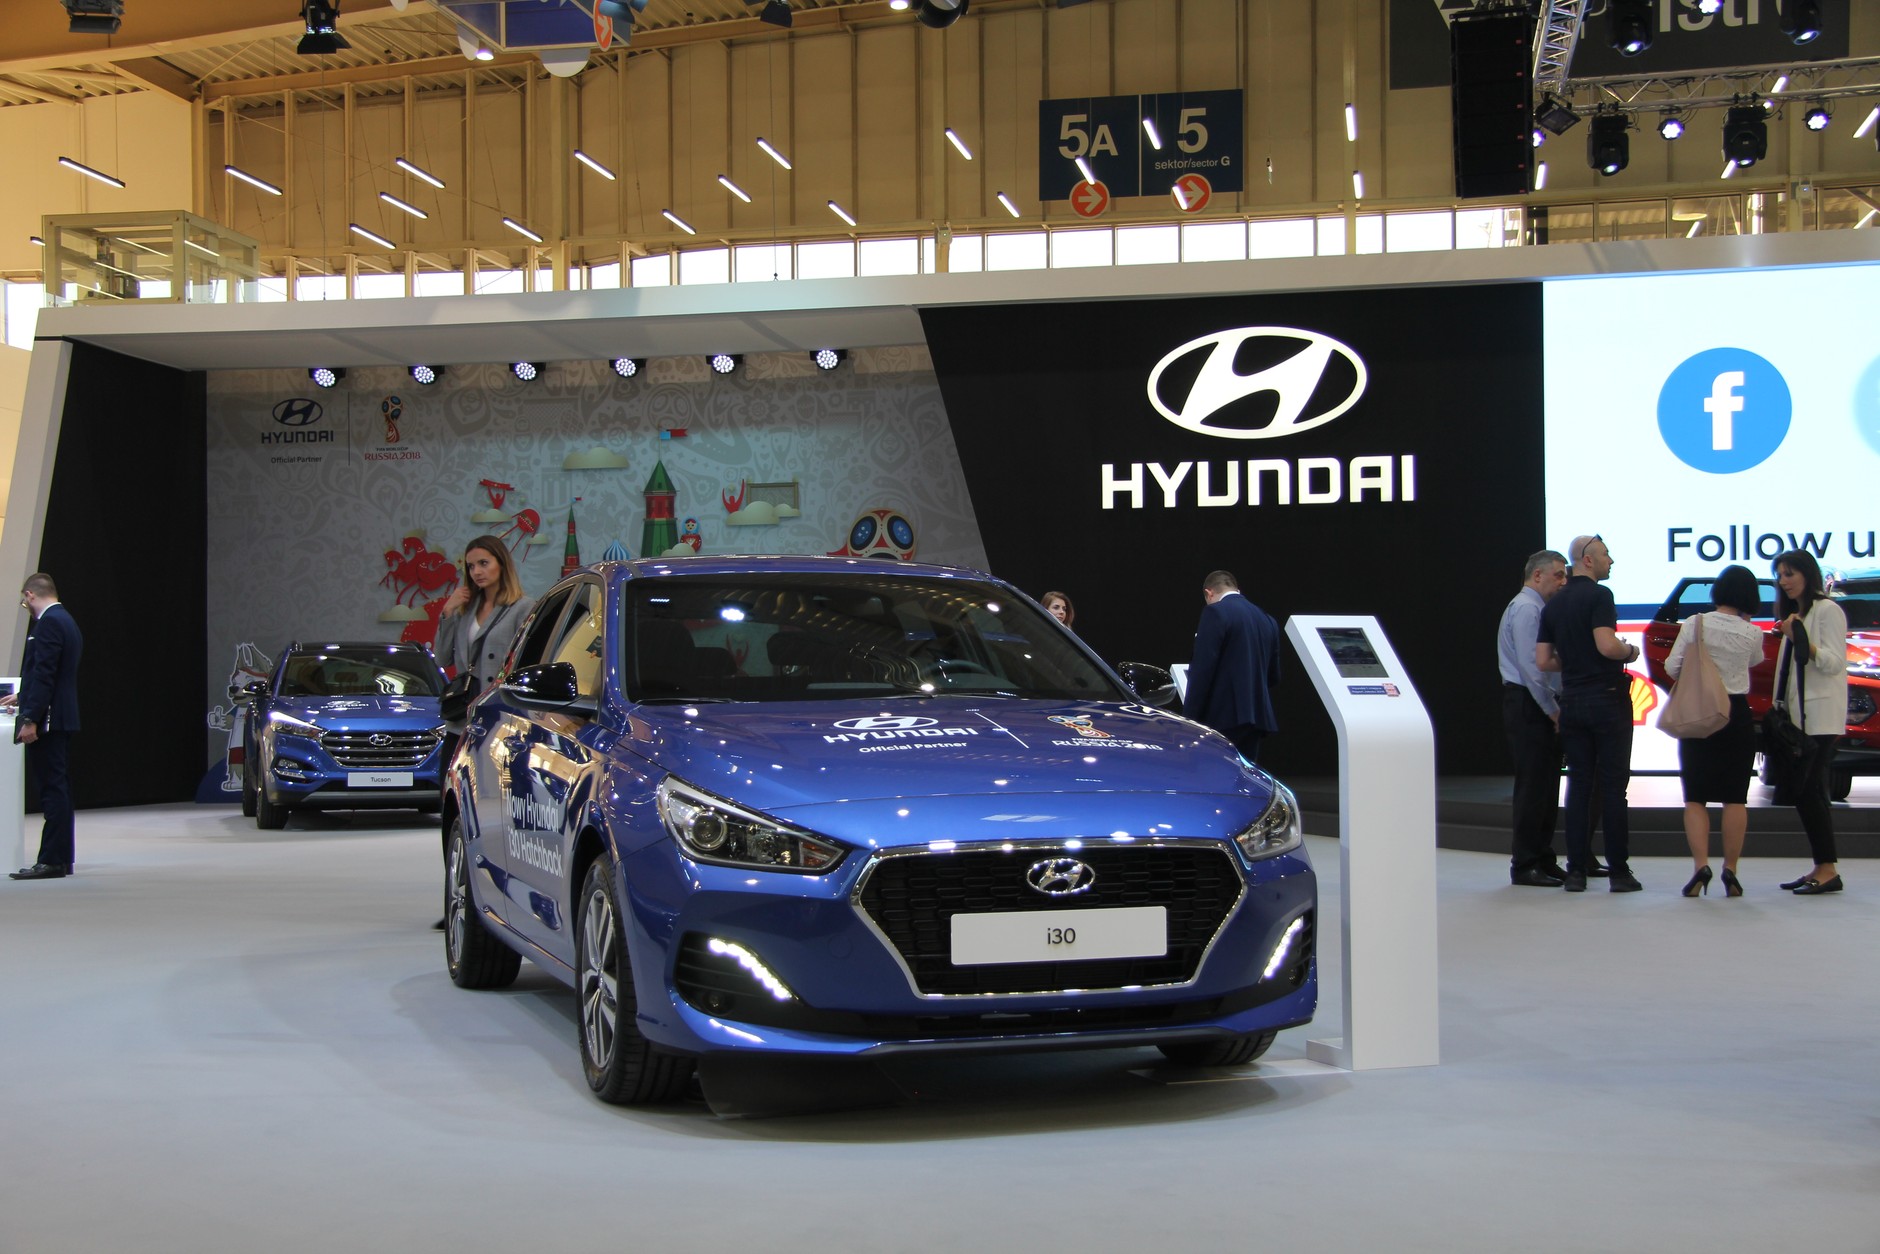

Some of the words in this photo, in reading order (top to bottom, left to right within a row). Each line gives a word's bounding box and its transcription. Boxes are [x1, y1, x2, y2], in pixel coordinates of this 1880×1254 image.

[1058, 113, 1119, 160] 5A
[1177, 107, 1209, 154] 5
[1154, 158, 1218, 171] sektor/sector
[1220, 155, 1231, 167] G
[261, 430, 334, 444] HYUNDAI
[270, 456, 296, 464] Official
[364, 452, 399, 461] RUSSIA
[400, 451, 421, 460] 2018
[1101, 454, 1415, 510] HYUNDAI
[1667, 524, 1832, 563] Follow
[1847, 530, 1880, 559] u
[823, 727, 979, 743] HYUNDAI
[858, 743, 912, 753] Official
[914, 742, 968, 750] Partner
[1051, 740, 1124, 748] RUSSIA
[1121, 742, 1164, 751] 218
[506, 787, 526, 829] Nowy
[526, 793, 559, 833] Hyundai
[521, 833, 564, 878] Hatchback
[1047, 927, 1077, 945] i30
